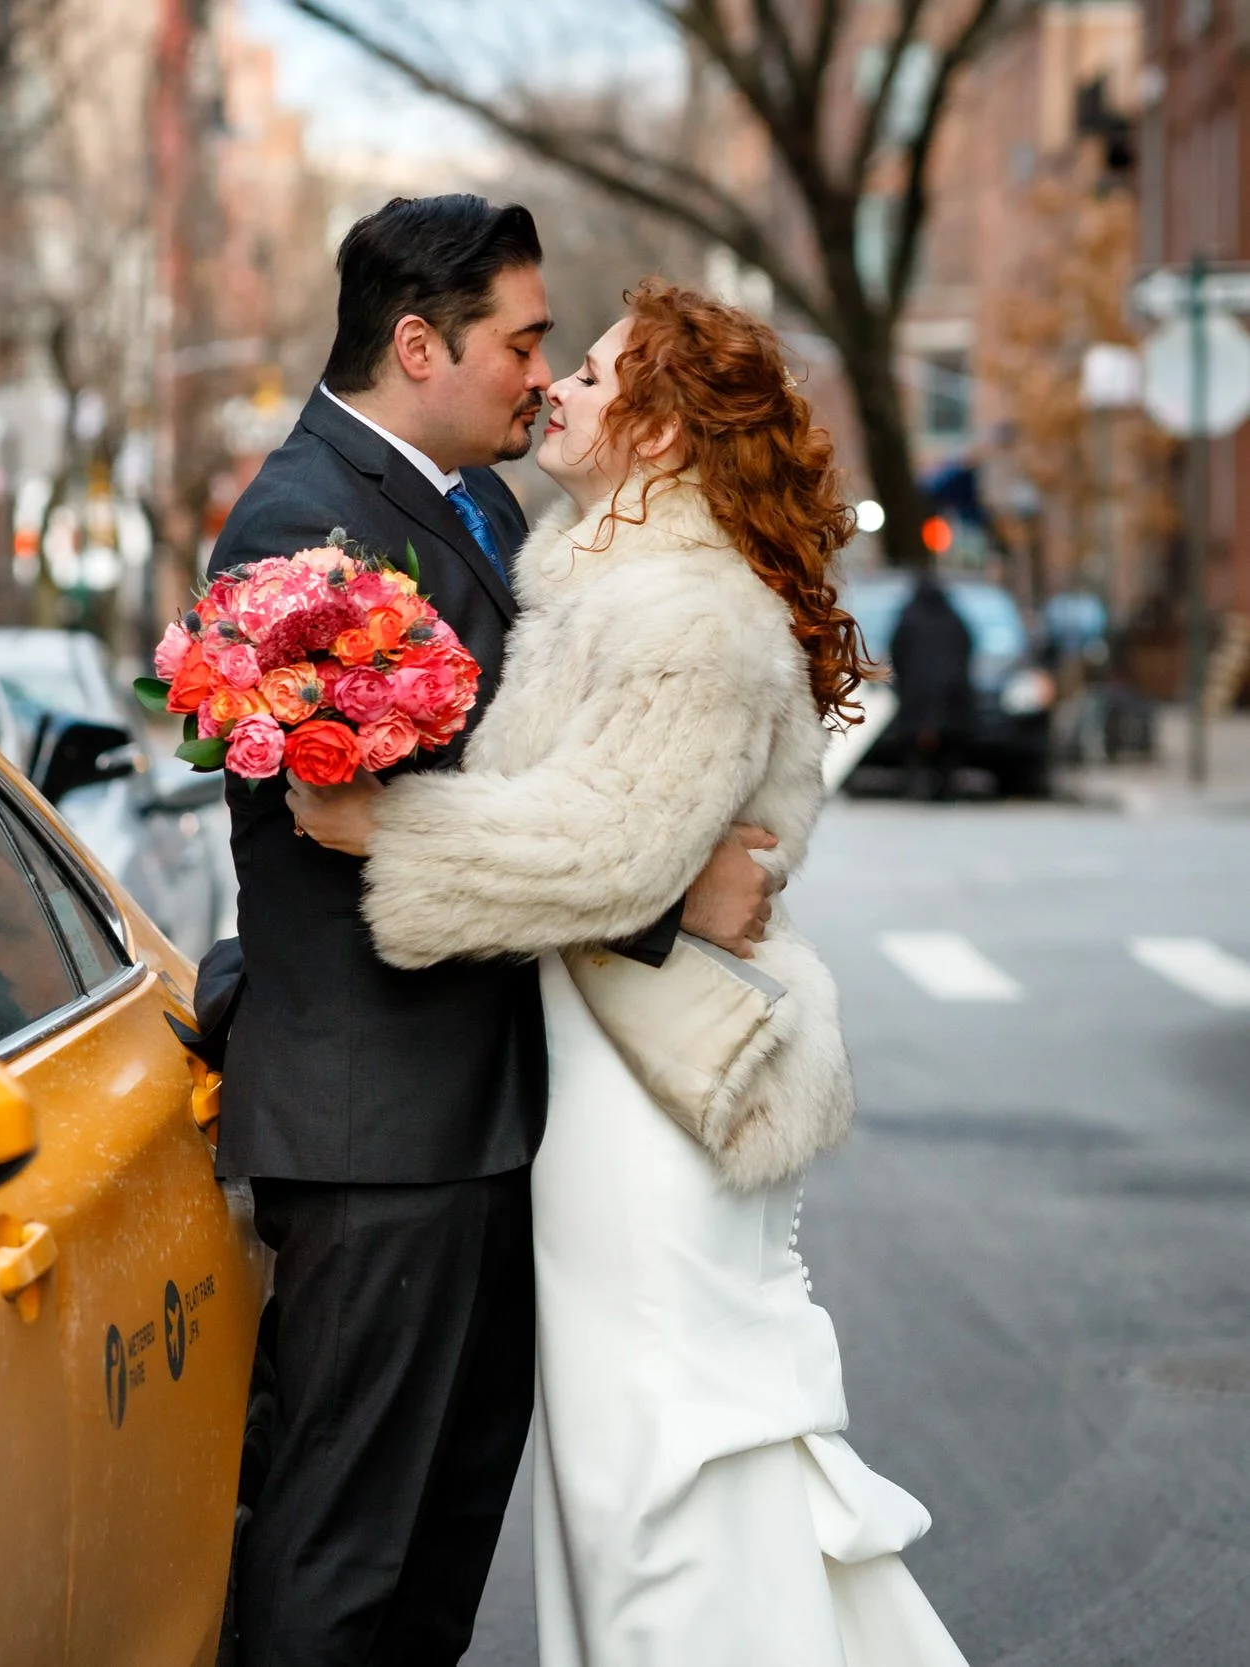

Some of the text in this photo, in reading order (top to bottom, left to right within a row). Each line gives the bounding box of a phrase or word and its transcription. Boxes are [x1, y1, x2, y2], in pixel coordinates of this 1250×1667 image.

[184, 1274, 216, 1313] FLAT FARE
[188, 1319, 200, 1346] JFK
